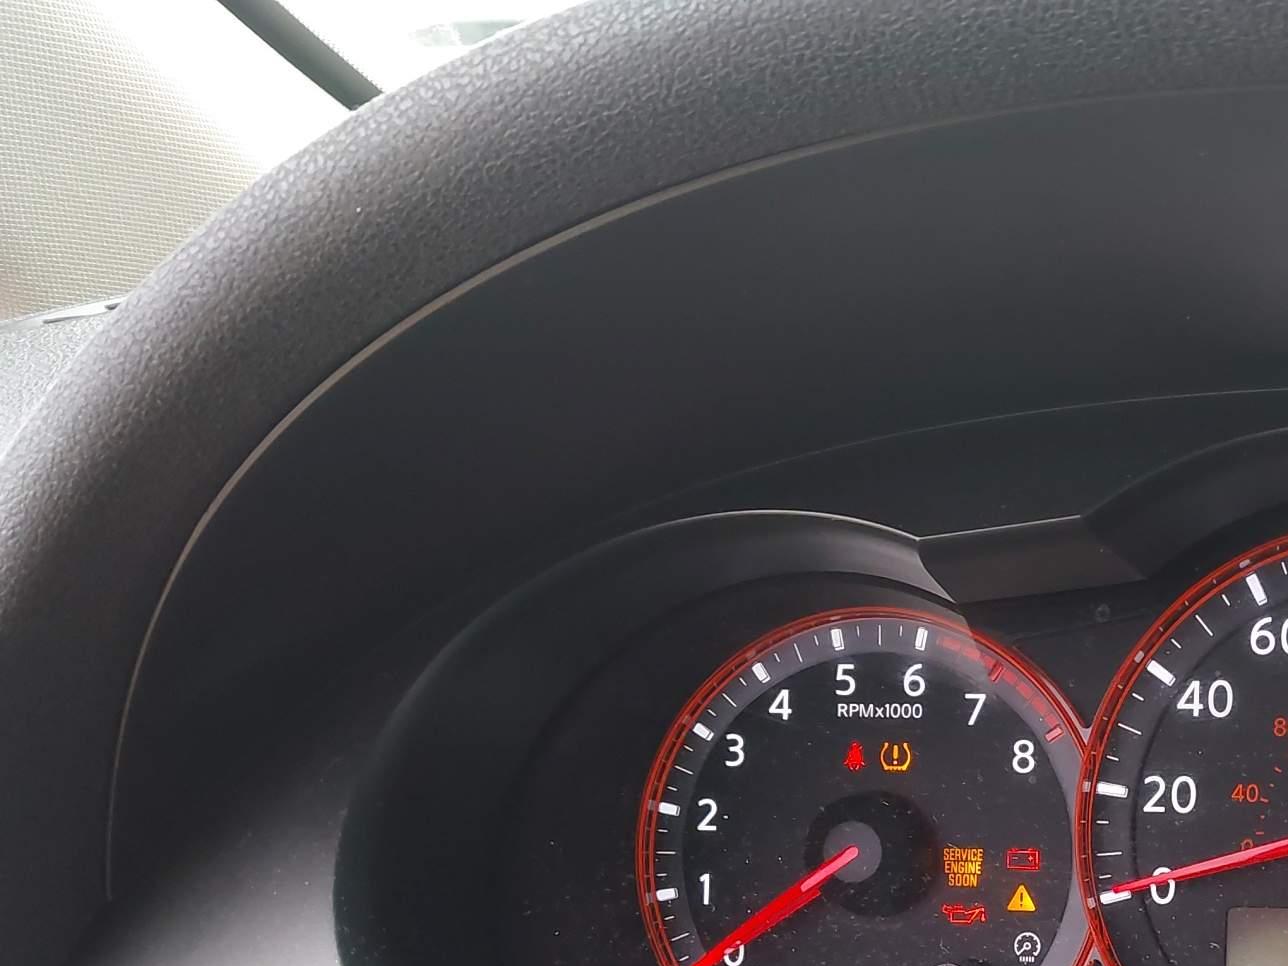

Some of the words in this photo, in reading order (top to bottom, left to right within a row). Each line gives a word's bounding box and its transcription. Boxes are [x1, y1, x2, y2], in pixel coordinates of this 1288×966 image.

[835, 664, 856, 696] 5
[903, 663, 926, 697] 6
[769, 689, 793, 720] 4
[837, 704, 923, 719] RPMx1000
[964, 693, 987, 726] 7
[1176, 680, 1234, 718] 40
[725, 734, 745, 767] 3
[1012, 739, 1035, 774] 8
[1143, 776, 1197, 814] 20
[1231, 783, 1260, 803] 40
[697, 798, 717, 831] 2
[943, 848, 984, 861] SERVICE
[944, 861, 982, 874] ENGINE
[699, 874, 711, 906] 1
[948, 874, 978, 887] SOON
[1150, 867, 1176, 905] 0
